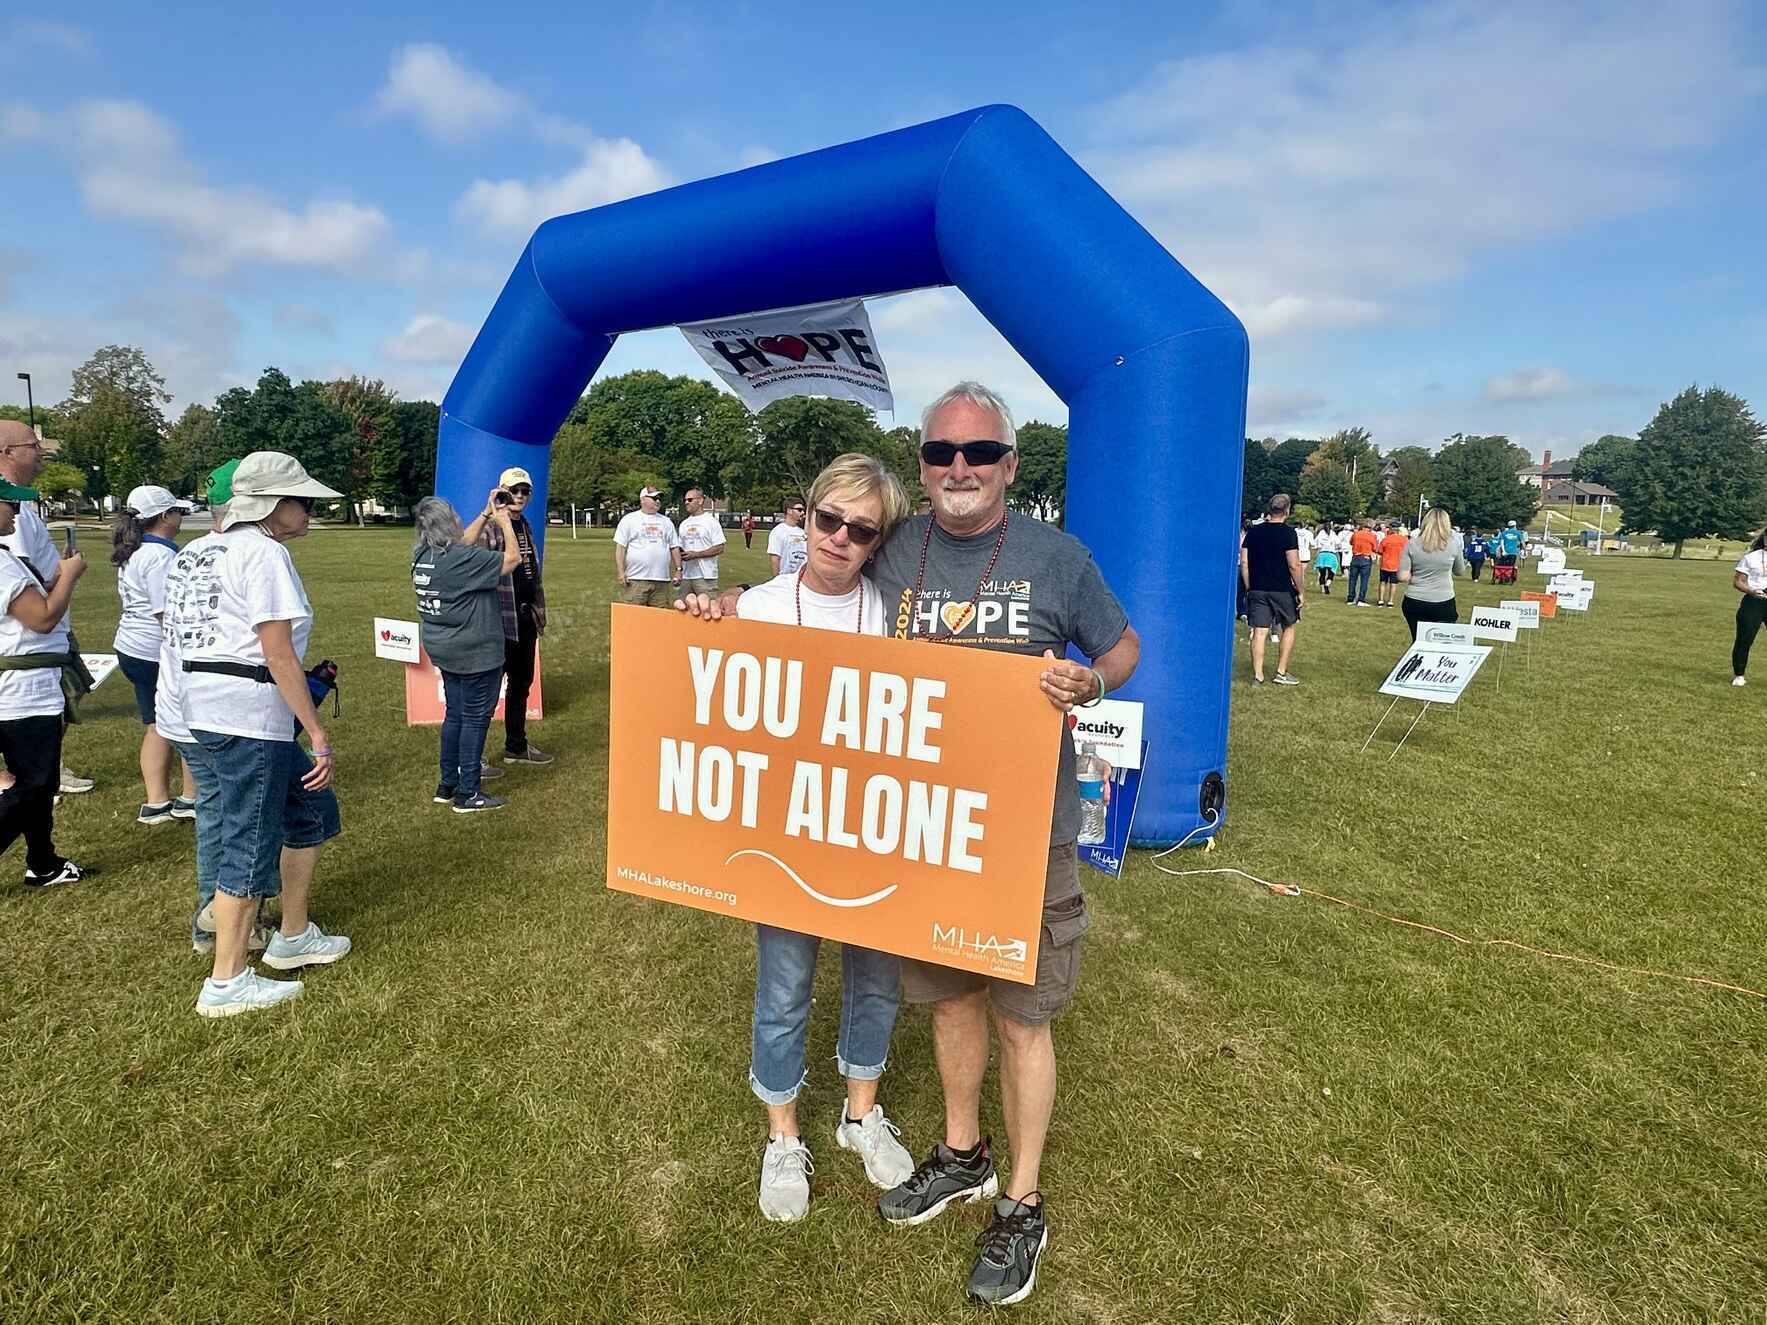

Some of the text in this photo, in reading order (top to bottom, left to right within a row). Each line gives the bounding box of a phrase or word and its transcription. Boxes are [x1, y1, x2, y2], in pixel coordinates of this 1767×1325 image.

[703, 328, 738, 339] there
[943, 589, 951, 599] is
[895, 588, 913, 641] 2024
[1474, 618, 1512, 630] KOHLER
[391, 633, 411, 645] acuity
[1438, 656, 1458, 669] You
[1415, 669, 1460, 683] Matter
[687, 645, 946, 763] YOU ARE
[1077, 720, 1125, 738] acuity
[658, 737, 988, 874] NOT ALONE
[617, 866, 738, 906] MHALakeshore.org
[933, 921, 1003, 958] MHA
